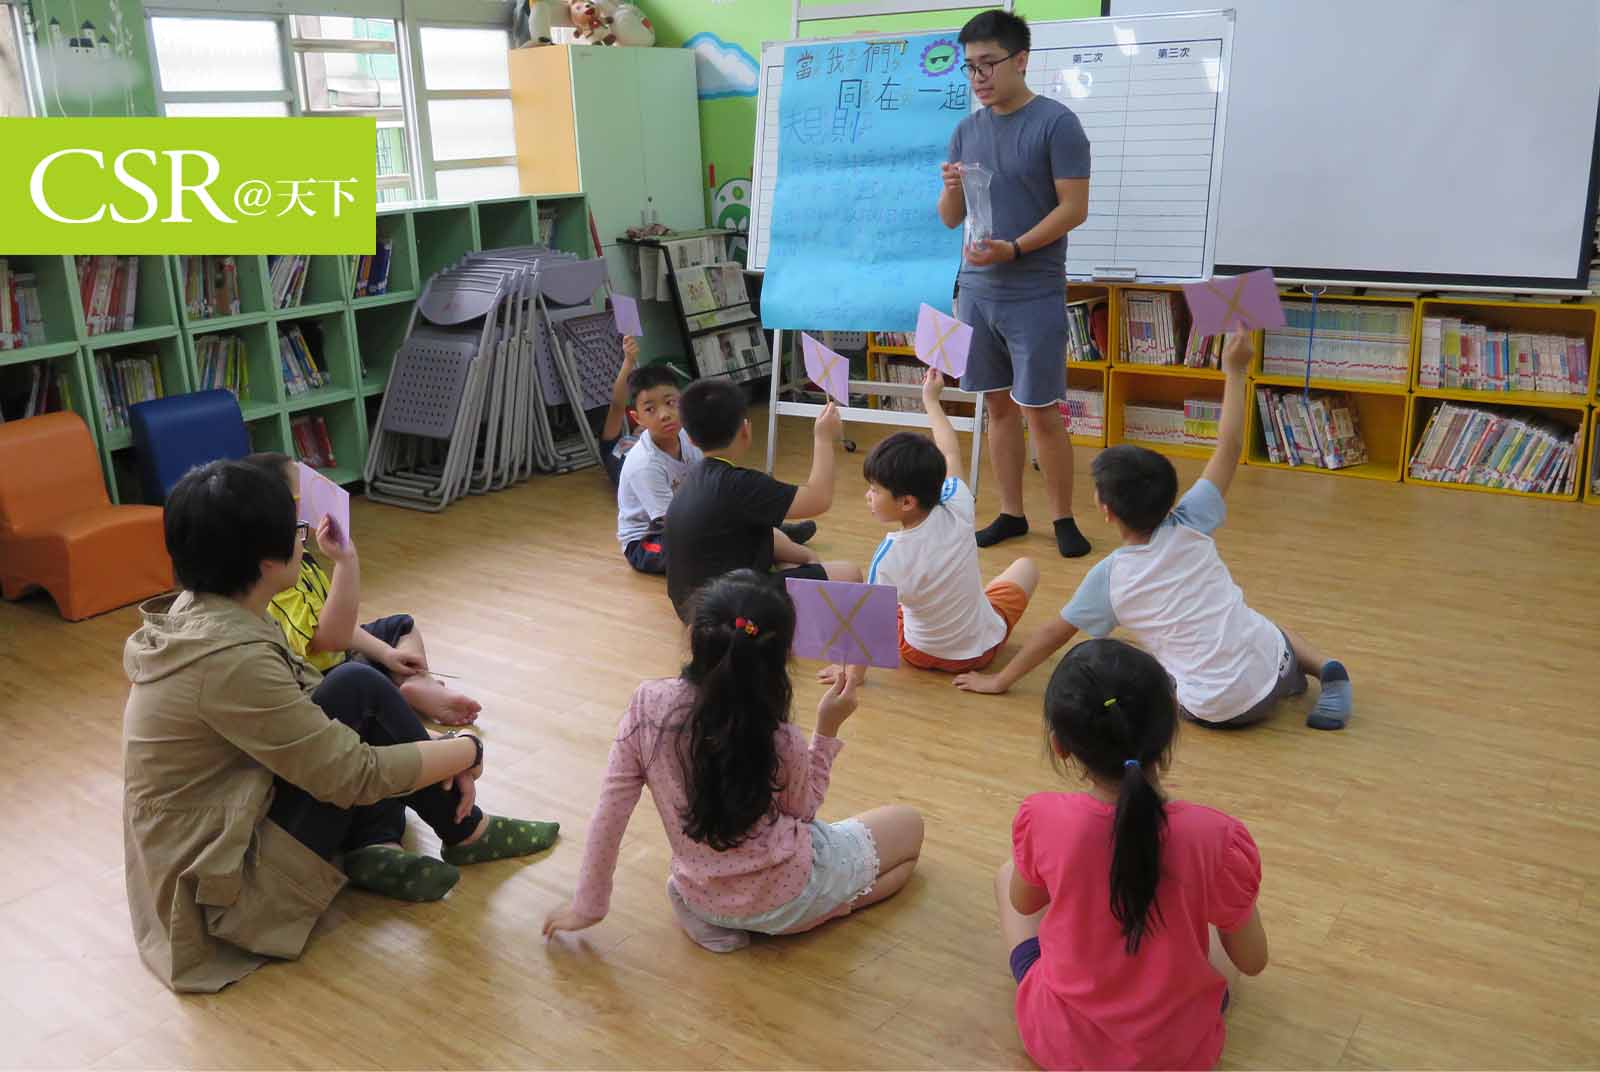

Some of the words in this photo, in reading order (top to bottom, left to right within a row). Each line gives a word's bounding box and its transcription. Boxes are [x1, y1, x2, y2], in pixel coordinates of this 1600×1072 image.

[1072, 52, 1104, 64] 第二次
[1157, 47, 1191, 59] 第三次
